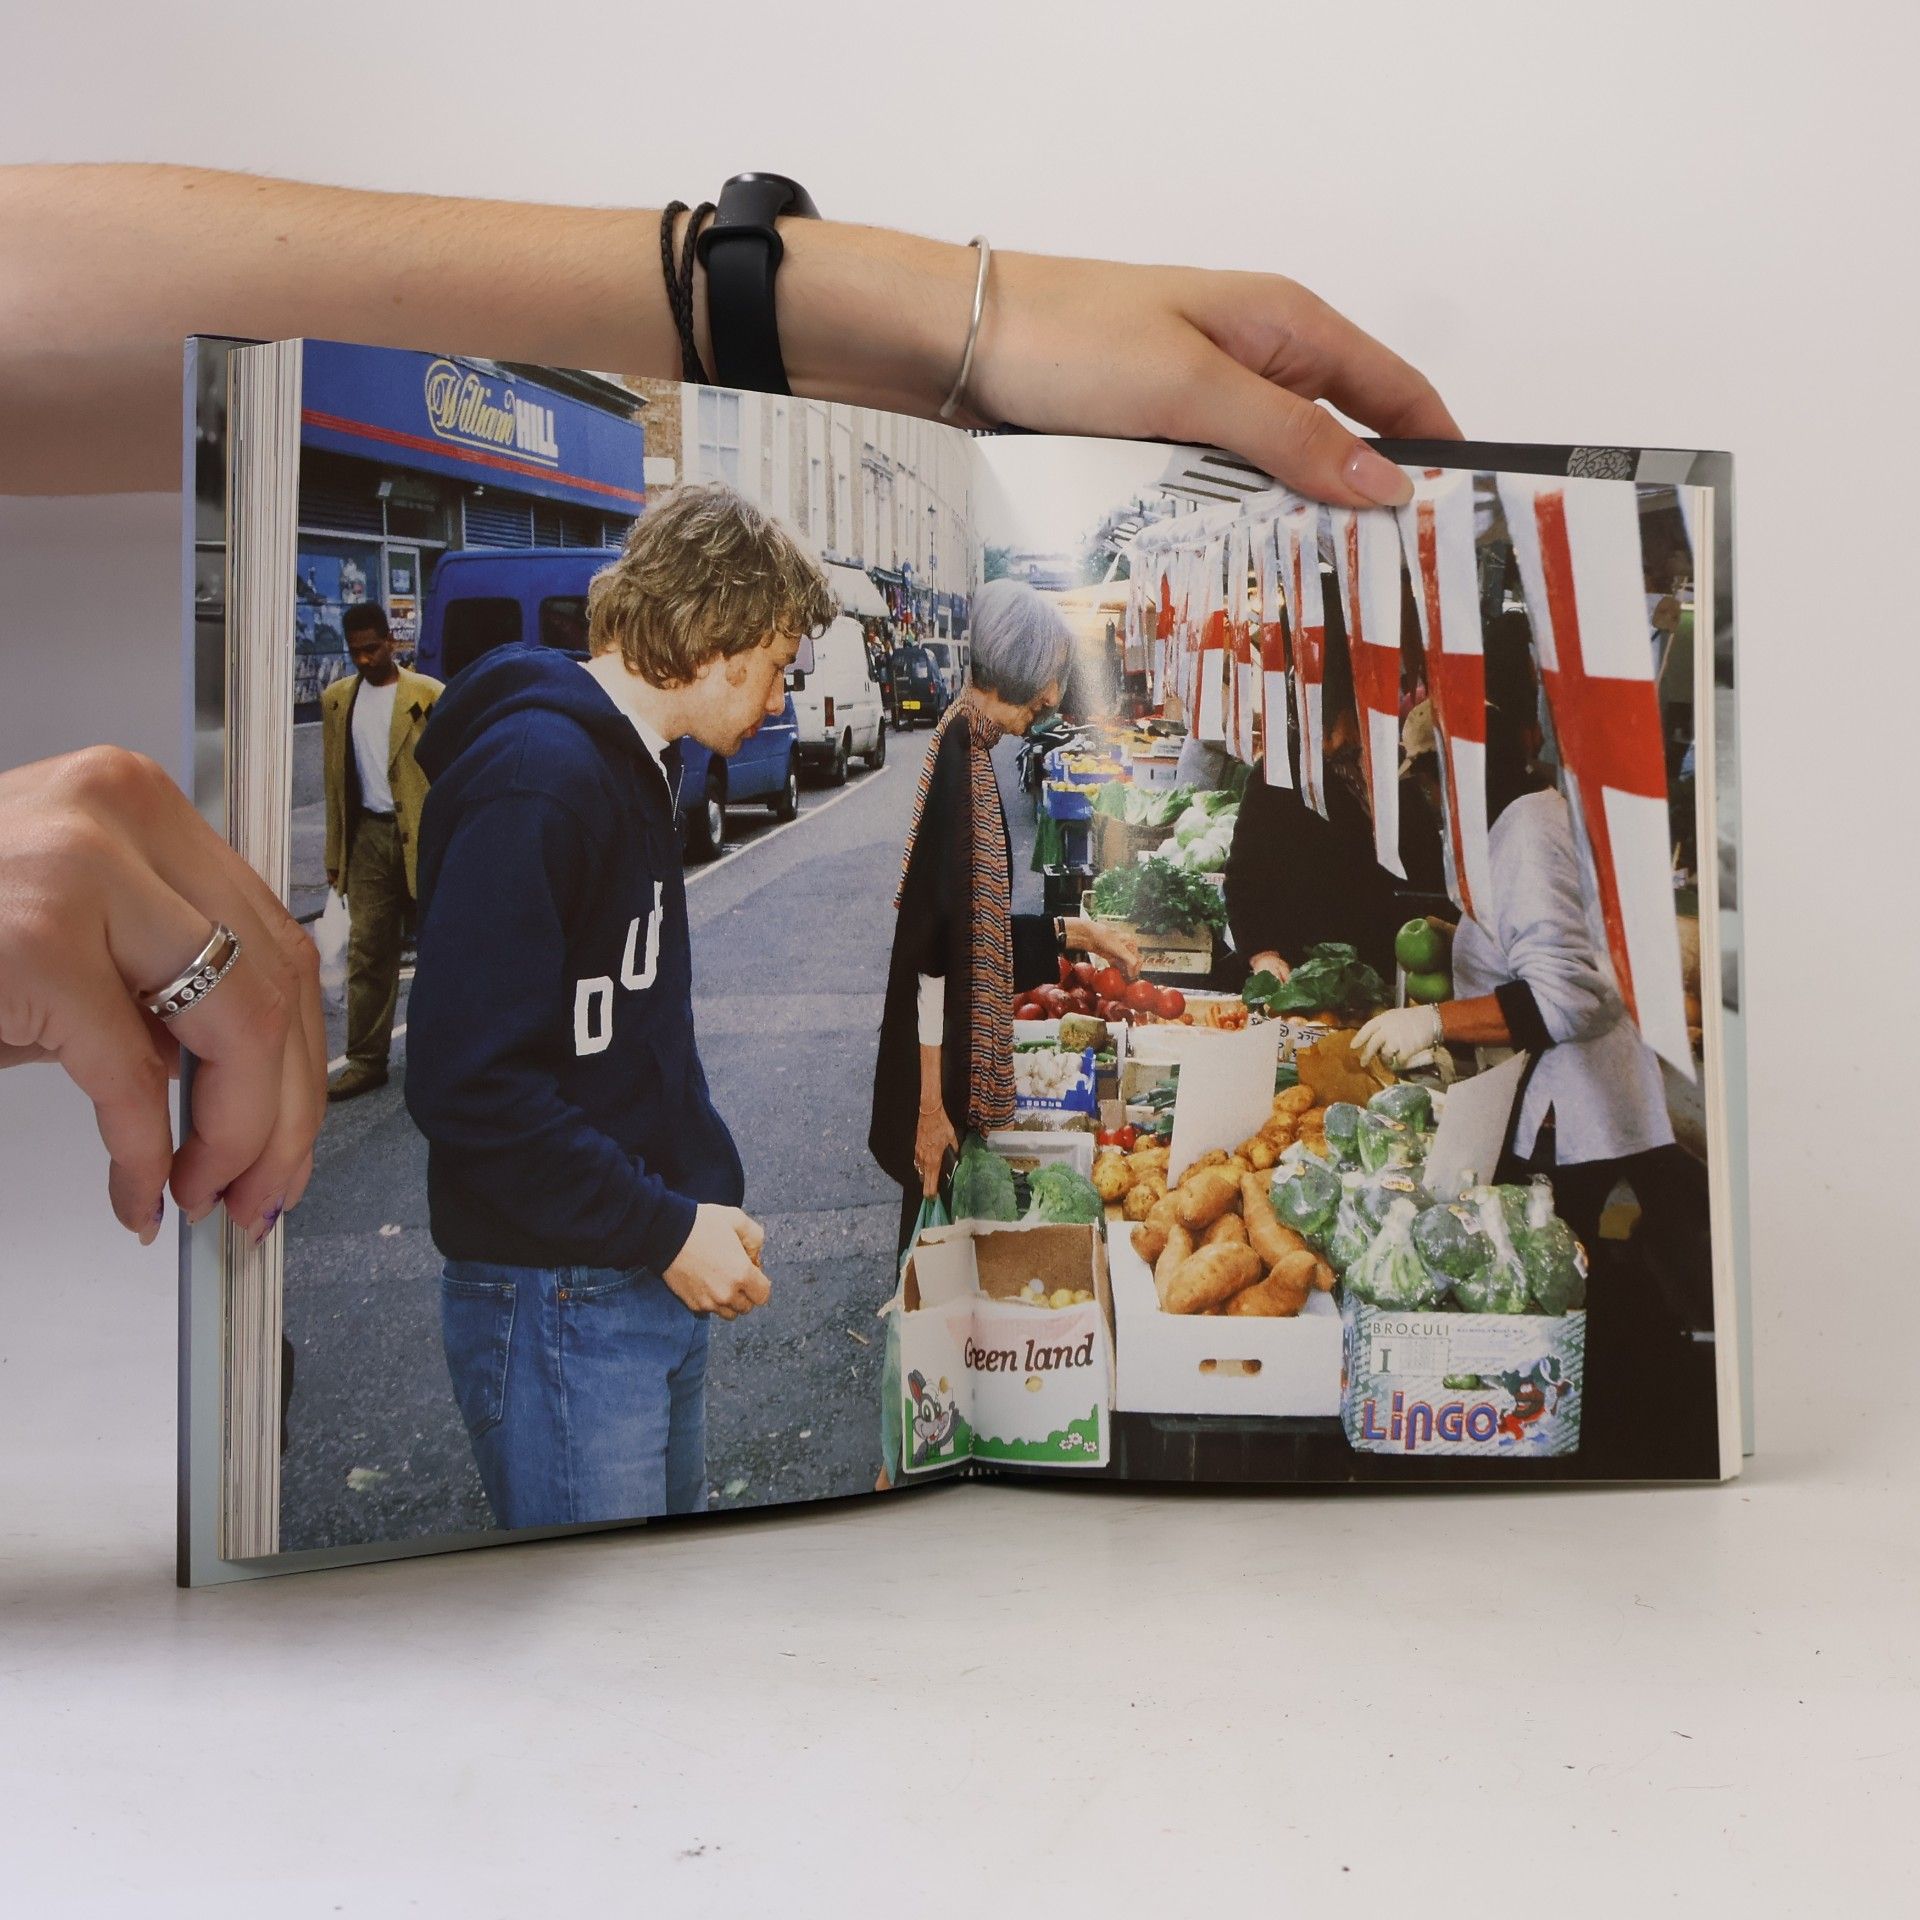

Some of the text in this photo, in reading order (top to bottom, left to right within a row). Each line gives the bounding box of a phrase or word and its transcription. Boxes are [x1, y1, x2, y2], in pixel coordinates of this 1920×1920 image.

[424, 358, 559, 459] William HILL
[1024, 1331, 1095, 1372] land
